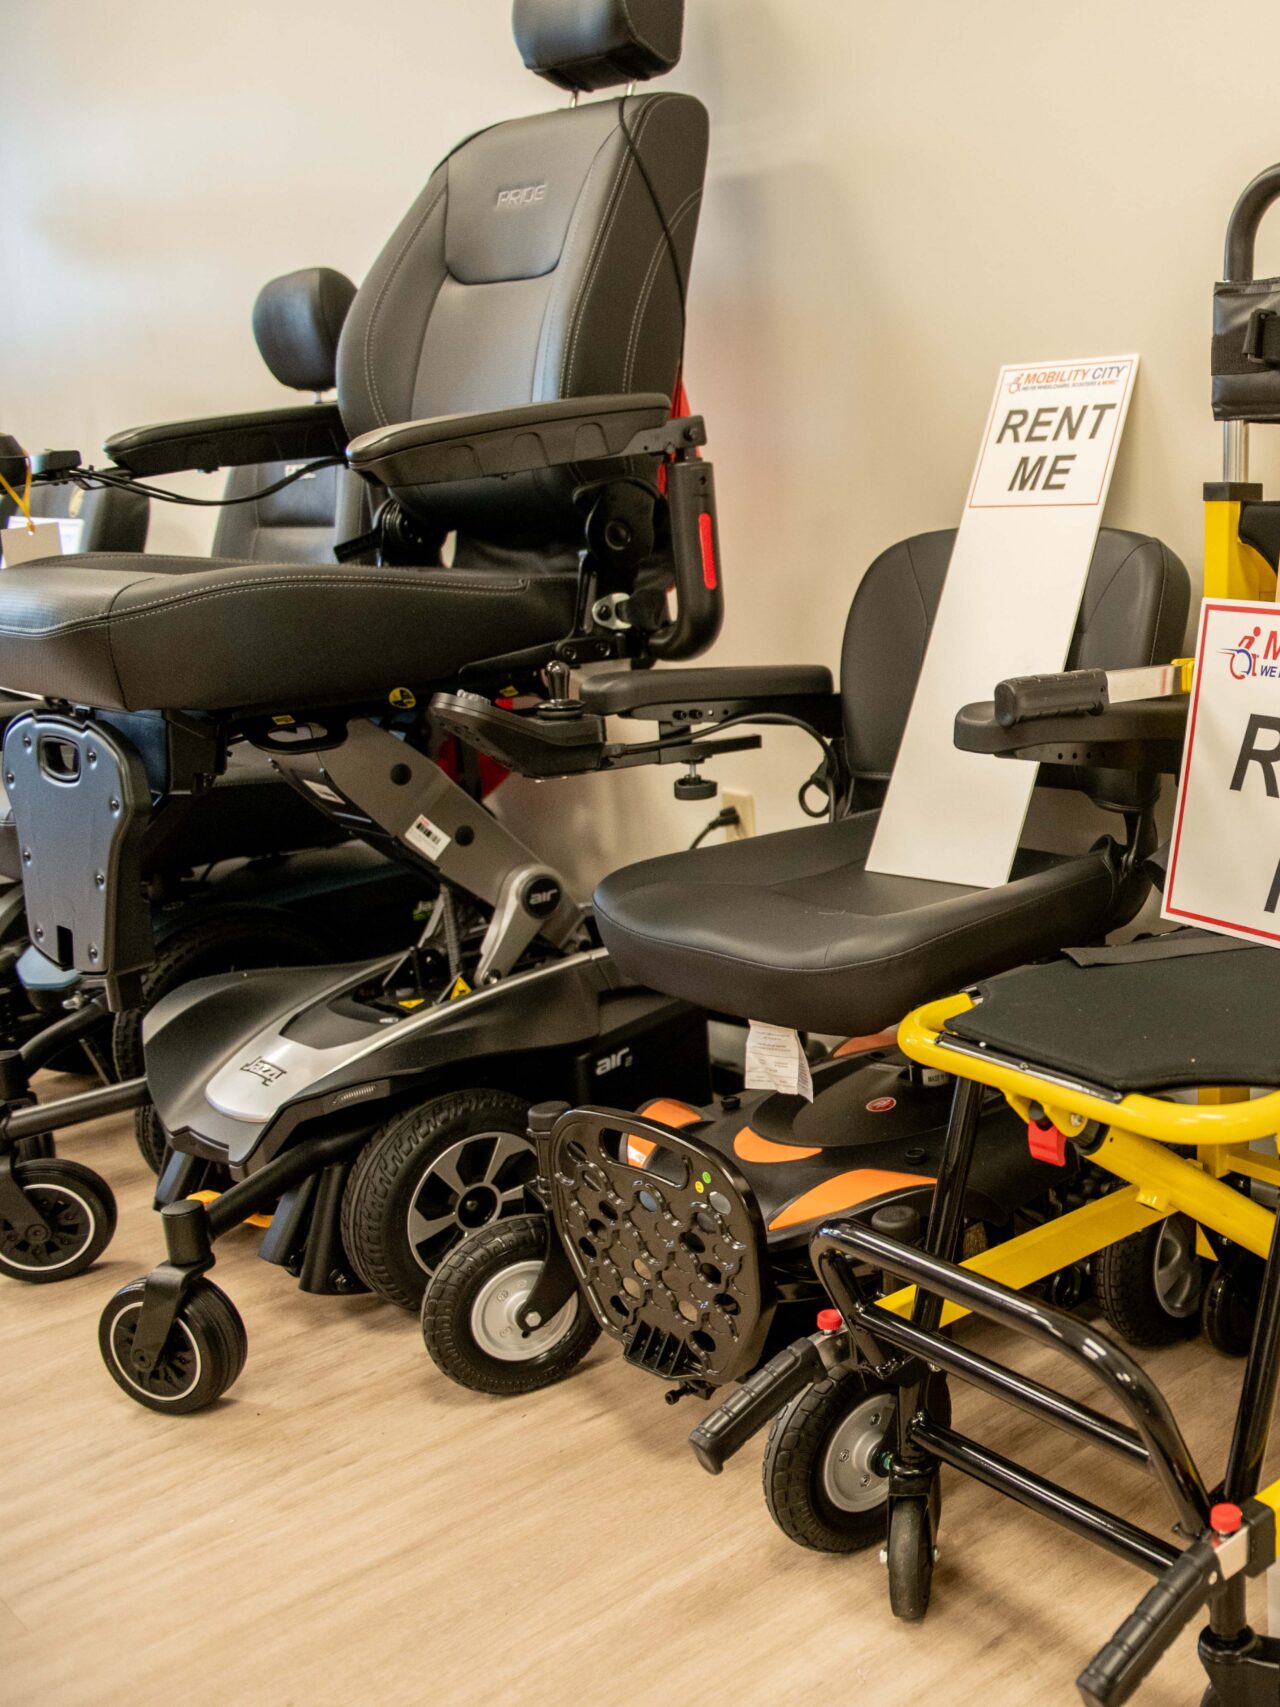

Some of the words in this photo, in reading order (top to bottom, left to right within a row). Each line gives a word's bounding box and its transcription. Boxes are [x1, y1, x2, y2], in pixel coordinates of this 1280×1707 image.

[496, 184, 547, 208] PRIDE
[1024, 368, 1091, 385] MOBILITY
[996, 403, 1117, 444] RENT
[1008, 454, 1077, 492] ME
[1260, 665, 1279, 678] WE
[529, 888, 558, 905] air
[595, 1046, 630, 1076] air
